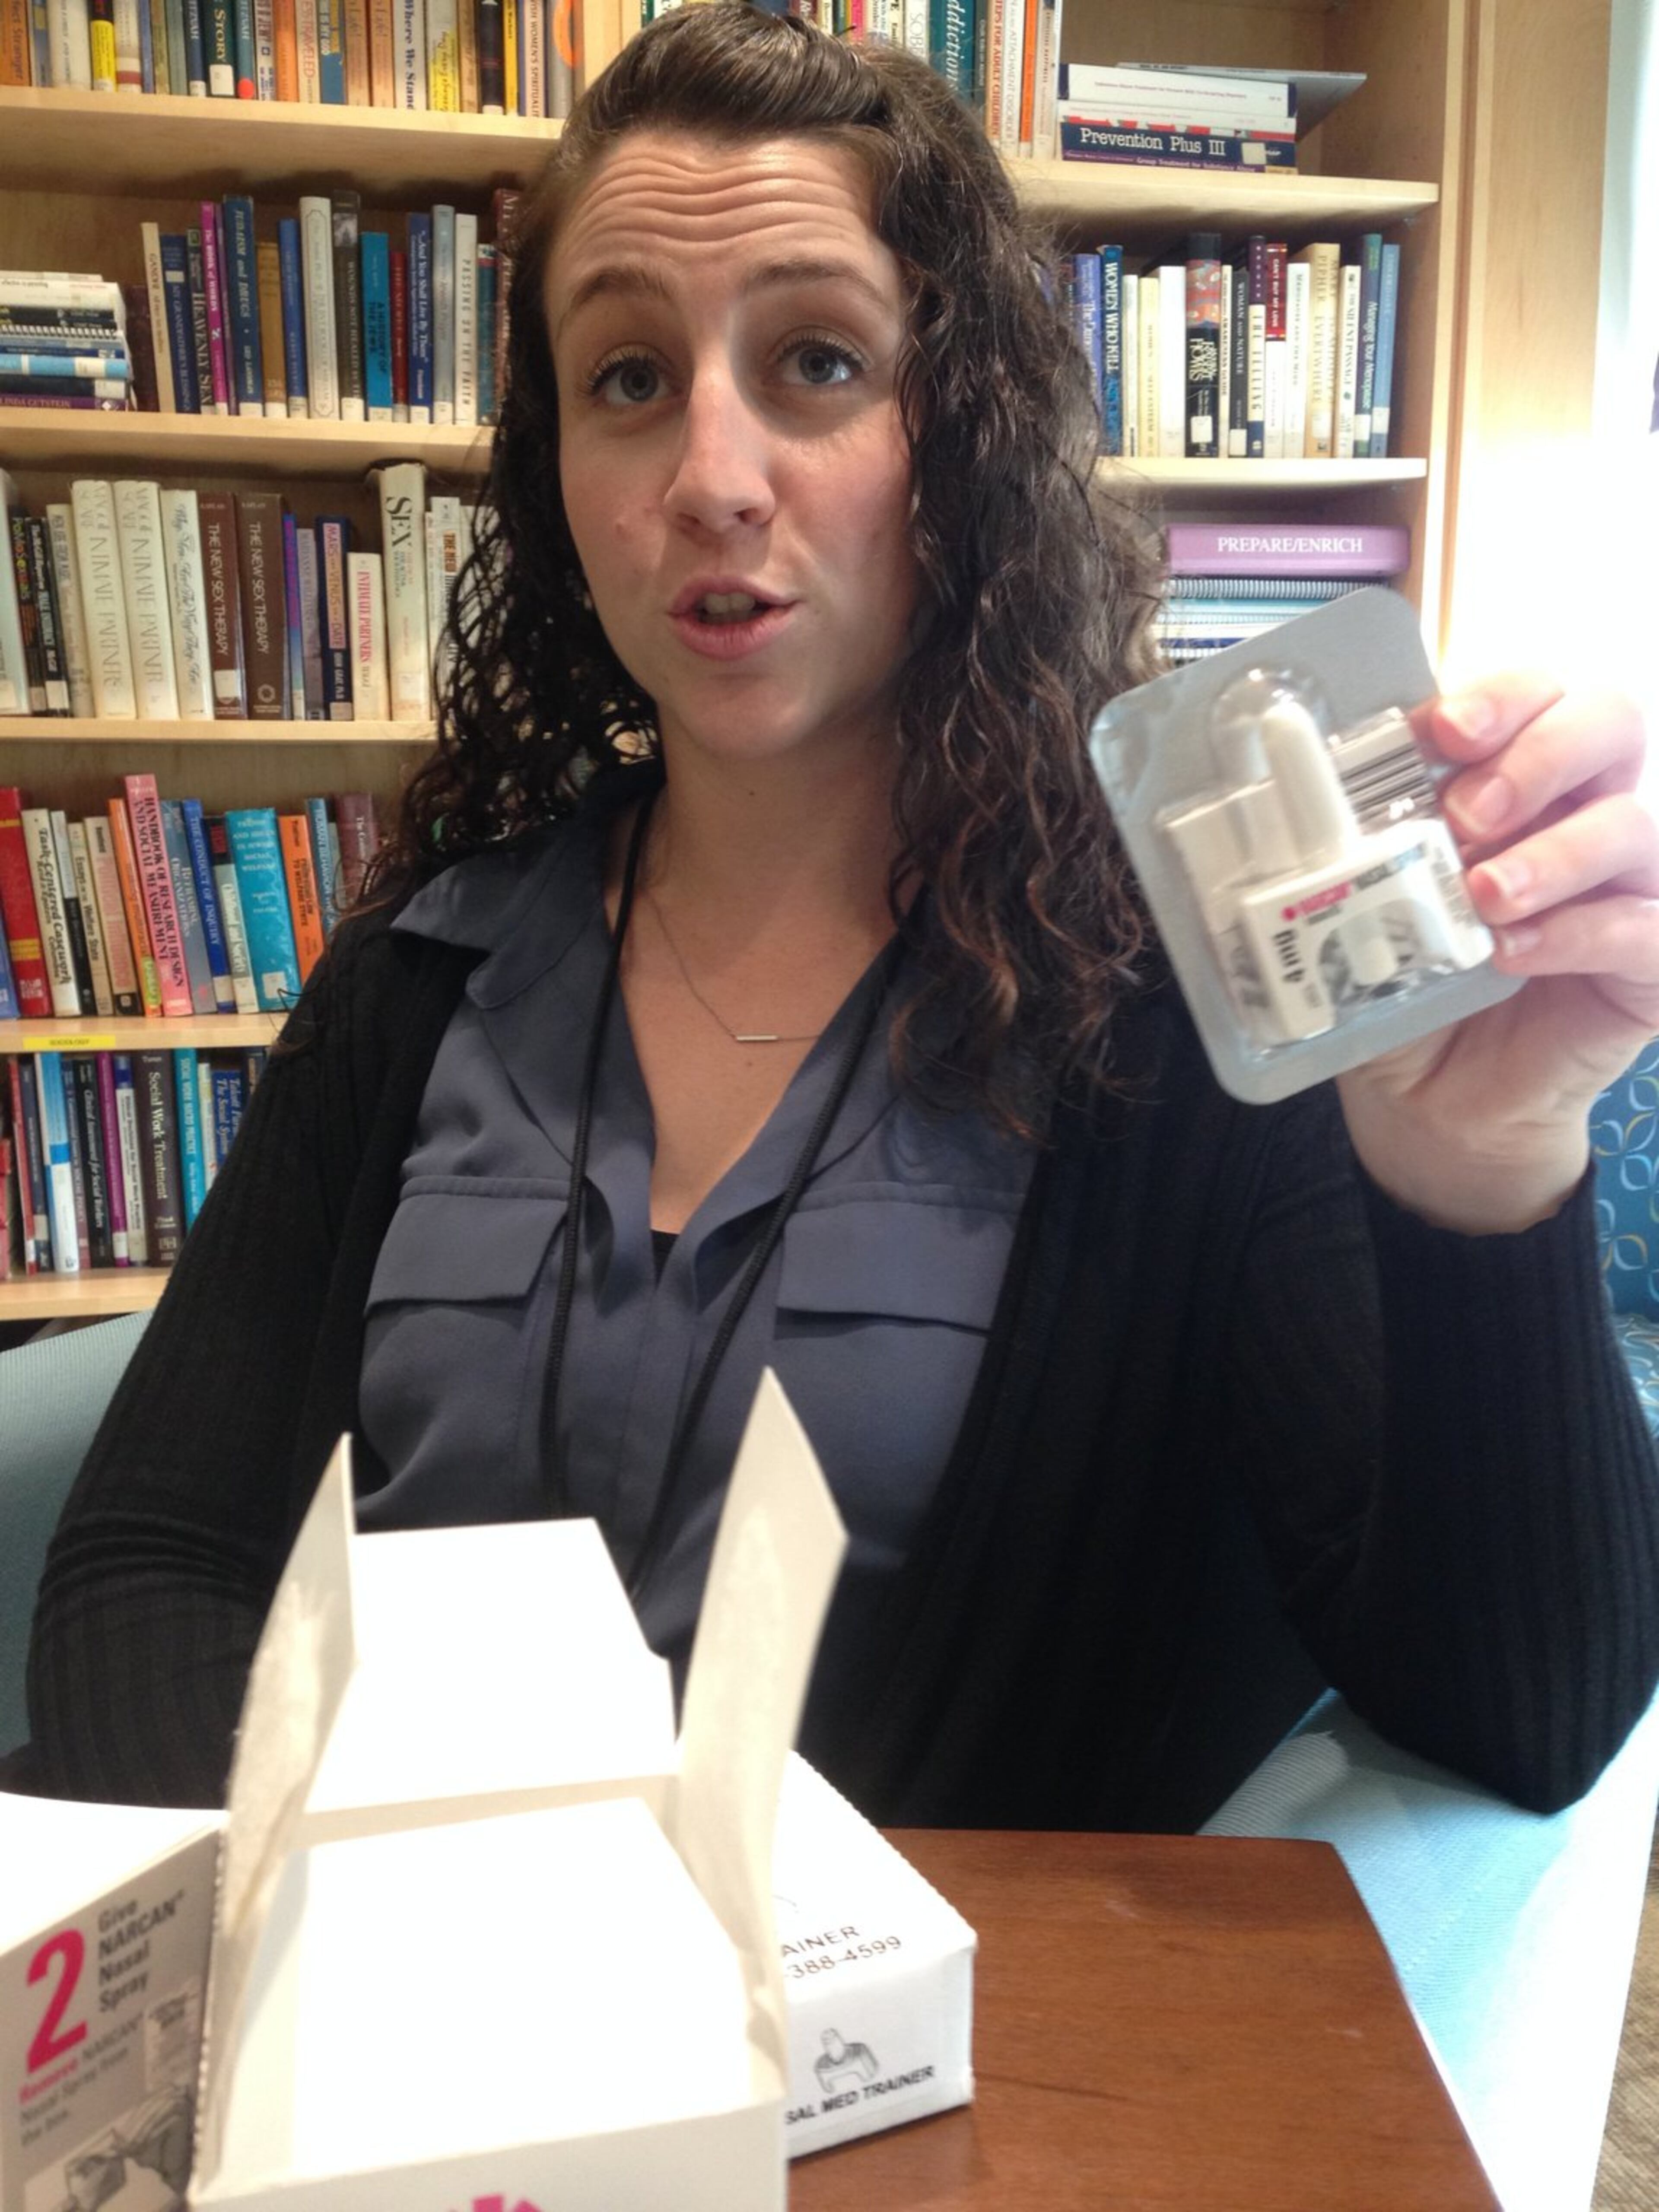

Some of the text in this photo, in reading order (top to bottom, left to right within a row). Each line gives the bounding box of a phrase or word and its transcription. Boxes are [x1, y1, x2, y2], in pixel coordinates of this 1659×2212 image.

[215, 9, 226, 61] STORY
[405, 0, 415, 44] Where
[531, 21, 539, 64] WOMEN'S
[301, 20, 315, 78] TRAVELED
[406, 48, 415, 67] We
[1007, 30, 1017, 92] ATTACHMENT
[992, 26, 1002, 136] FOR ADULT CHILDREN
[1081, 127, 1226, 156] Prevention Plus III
[347, 261, 356, 302] WOUNDS
[419, 261, 427, 276] You
[419, 279, 427, 299] Shall
[1105, 262, 1118, 311] WOMEN
[239, 282, 248, 317] DRUGS
[1272, 297, 1279, 308] MY
[419, 321, 428, 331] By
[462, 259, 471, 406] PASSING ON THE FAITH
[1106, 313, 1119, 344] WHO
[1344, 308, 1356, 385] SILENT PASSAGE
[192, 293, 212, 405] HEAVENLY SEX
[350, 329, 359, 368] HEALED
[1106, 345, 1119, 374] KILL
[1236, 338, 1244, 375] NATURE
[1362, 301, 1379, 408] Managing Your Menopause
[385, 496, 412, 547] SEX
[444, 534, 455, 550] THE
[1217, 536, 1364, 553] PREPARE/ENRICH
[209, 523, 228, 655] THE NEW SEX THERAPY
[249, 521, 269, 654] THE NEW SEX THERAPY
[327, 525, 343, 647] MARS VENUS DATE
[356, 571, 371, 616] INTIMATE
[358, 617, 372, 663] PARTNERS
[134, 801, 147, 823] AND
[314, 809, 327, 845] HUMAN
[137, 825, 154, 867] SOCIAL
[144, 798, 184, 987] HANDBOOK OF RESEARCH DESIGN
[190, 816, 220, 945] THE CONDUCT OF INQUIRY
[318, 847, 332, 894] BEHAVIOR
[38, 828, 72, 985] Task-Centered Casework
[74, 857, 86, 884] Essays
[83, 904, 95, 936] Welfare
[89, 939, 99, 961] State
[146, 872, 168, 960] MEASUREMENT
[171, 857, 191, 937] ORGANIZATIONS
[84, 1089, 95, 1119] Clinical
[217, 1079, 229, 1096] The
[230, 1078, 242, 1108] Talcott
[218, 1097, 230, 1124] Social
[149, 1071, 168, 1199] Social Work Treatment
[88, 1160, 101, 1173] for
[93, 1174, 103, 1196] Social
[95, 1199, 104, 1228] Workers
[98, 1899, 138, 1933] Give
[98, 1899, 178, 1960] NARCAN
[99, 1939, 151, 1986] Nasal
[26, 1929, 89, 2075] 2
[99, 1970, 150, 2013] Spray
[785, 2065, 935, 2126] SAL MED TRAINER
